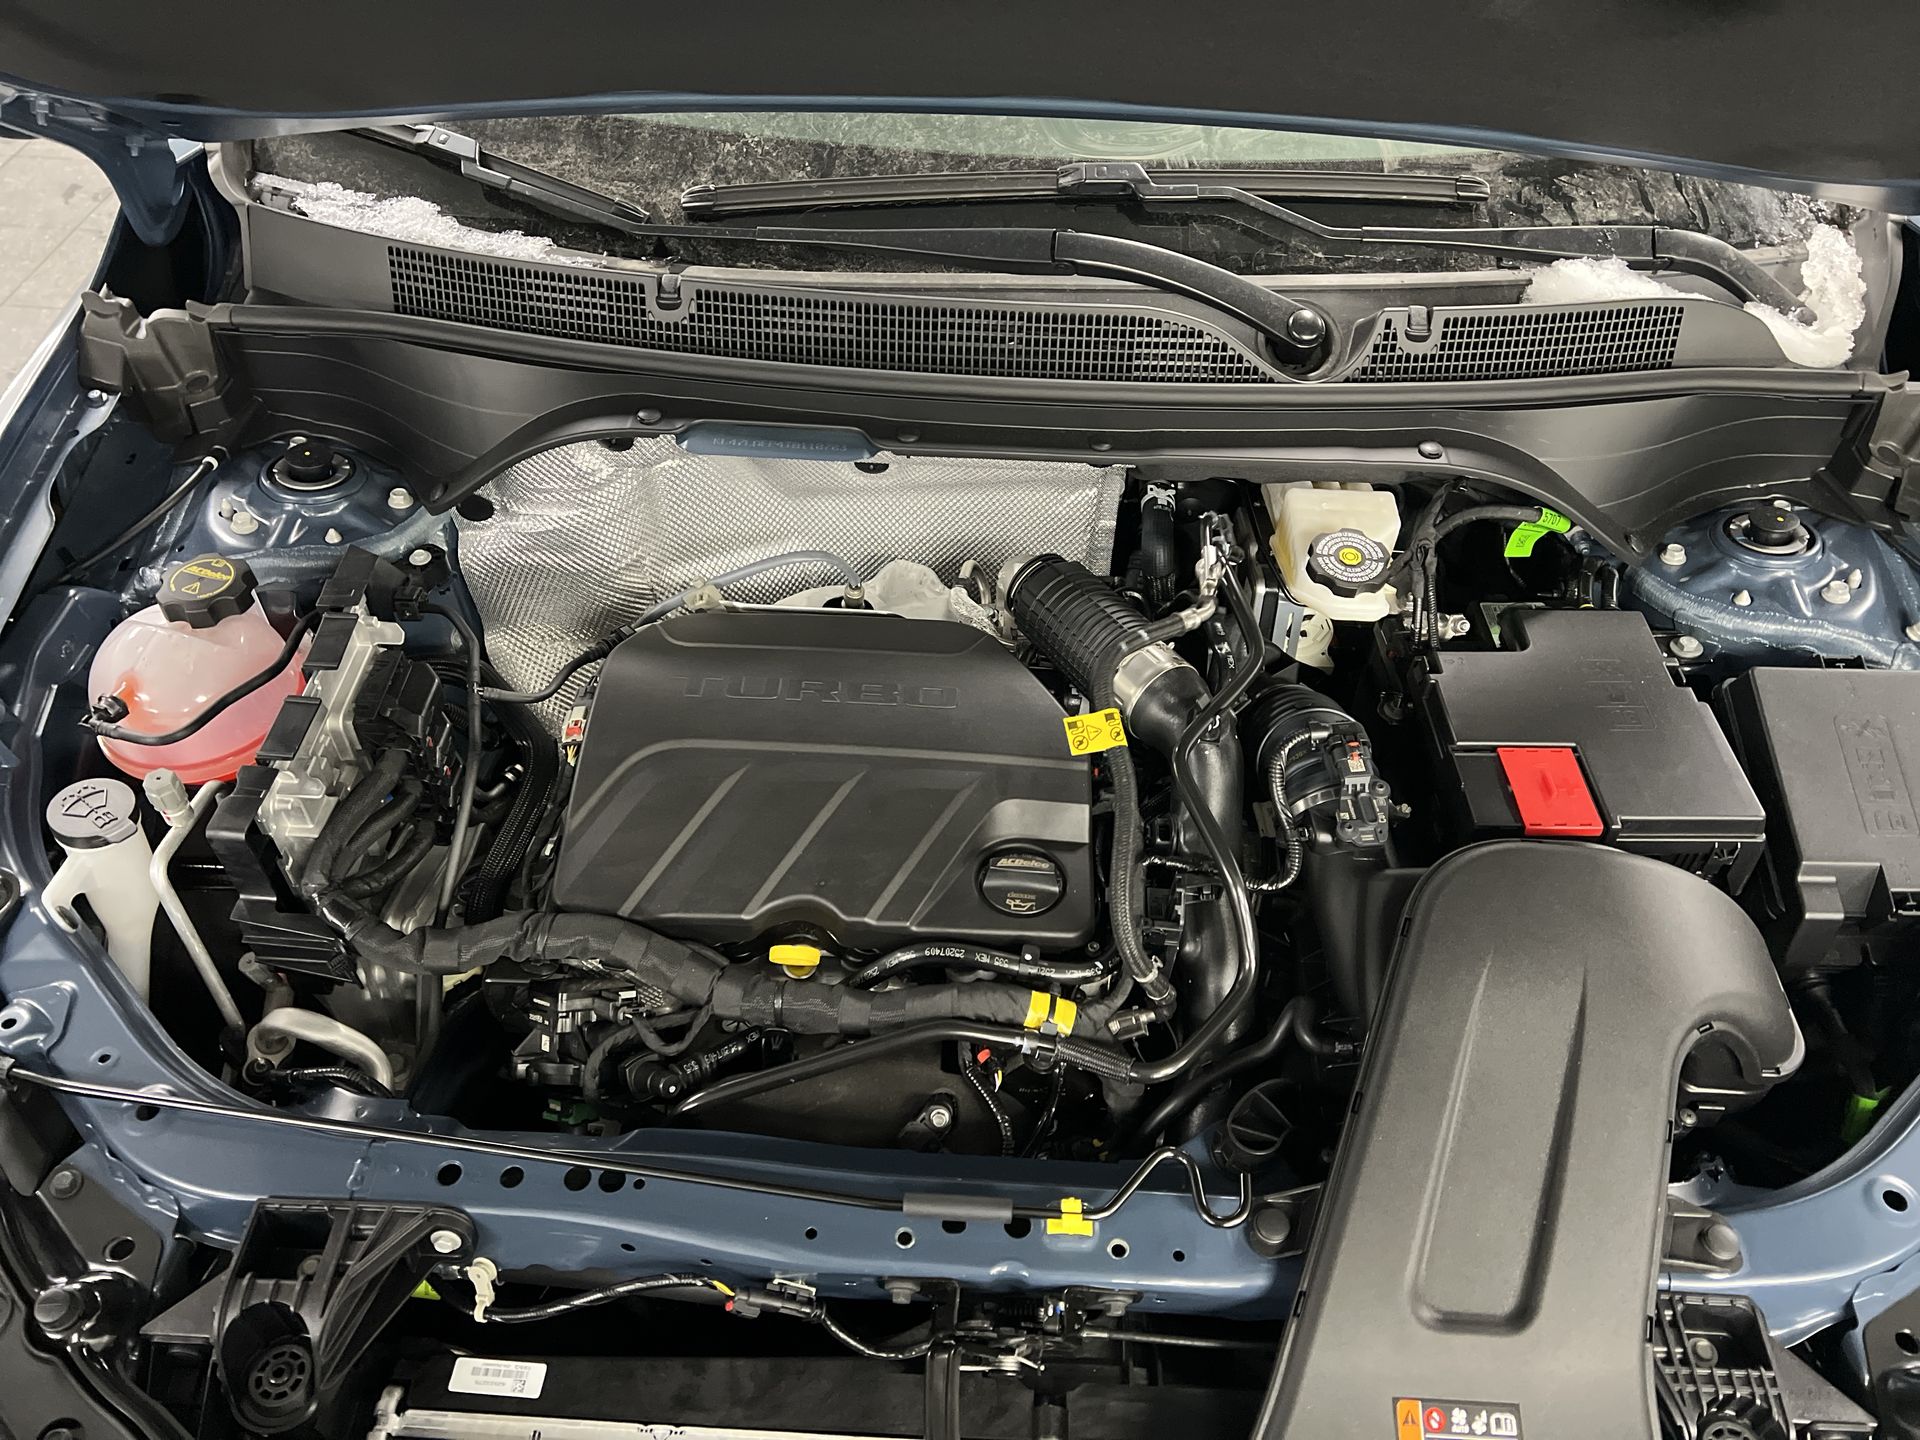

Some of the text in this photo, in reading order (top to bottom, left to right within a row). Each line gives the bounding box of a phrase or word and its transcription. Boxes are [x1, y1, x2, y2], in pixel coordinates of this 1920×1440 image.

[1542, 512, 1562, 527] 5707
[671, 675, 960, 709] TURBO
[997, 858, 1051, 869] ACDelco
[924, 948, 966, 959] 25207409
[974, 952, 991, 965] MEX
[993, 956, 1009, 967] 535
